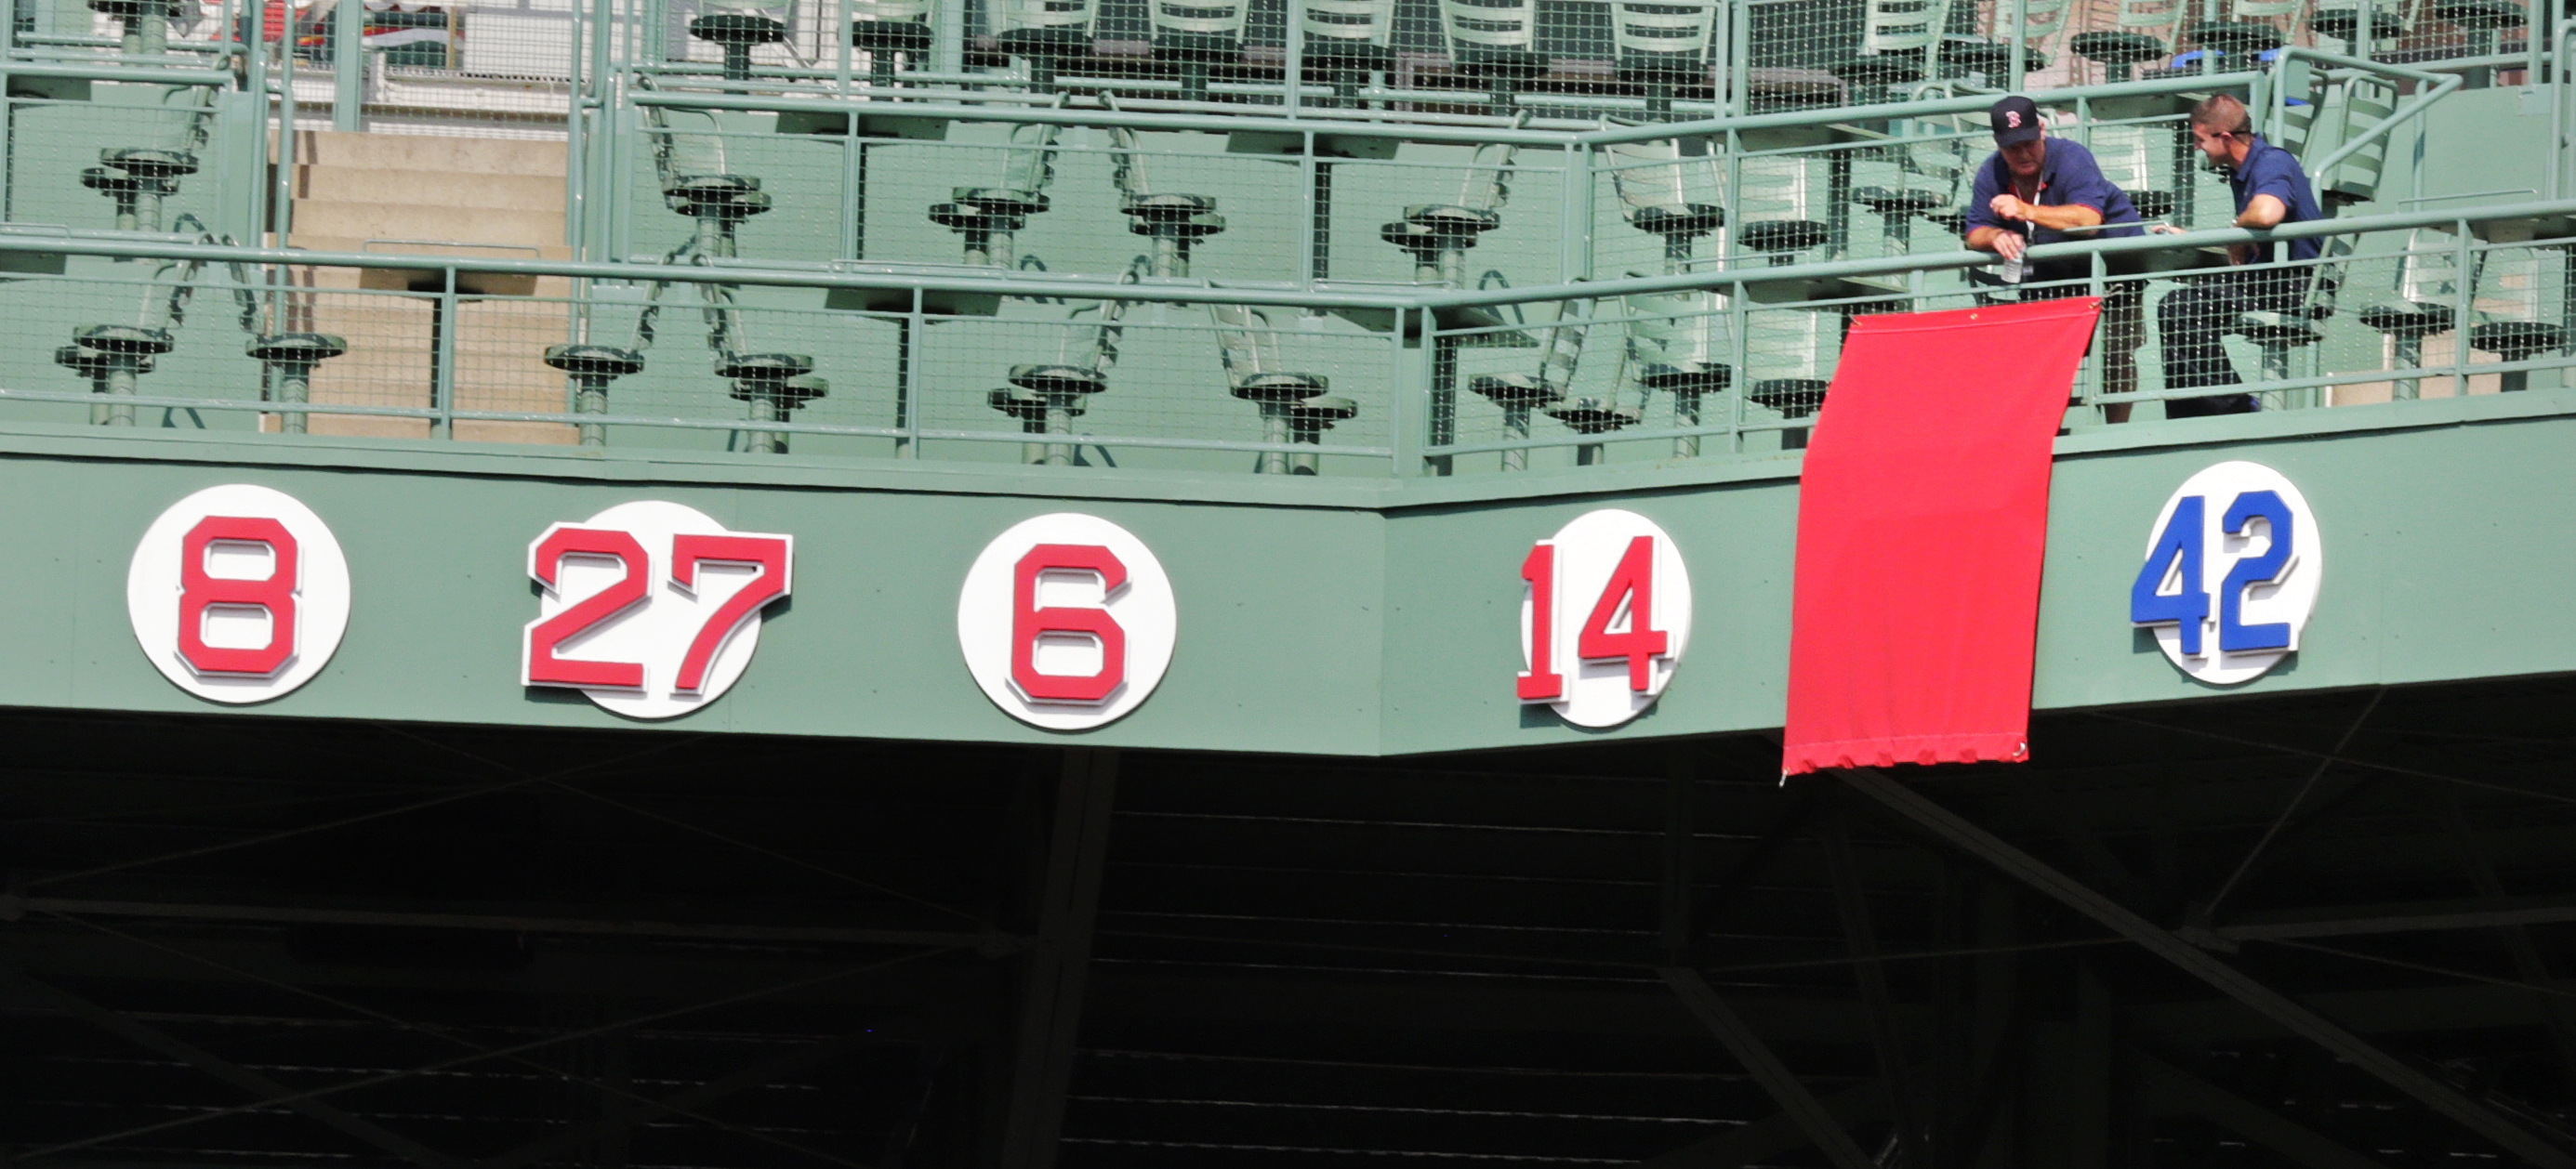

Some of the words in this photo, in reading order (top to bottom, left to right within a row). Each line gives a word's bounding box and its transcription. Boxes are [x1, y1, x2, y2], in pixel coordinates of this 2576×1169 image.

[177, 515, 298, 676] 8
[527, 527, 788, 691] 27
[1011, 543, 1128, 703] 6
[1516, 535, 1669, 702] 14
[2131, 491, 2293, 656] 42
